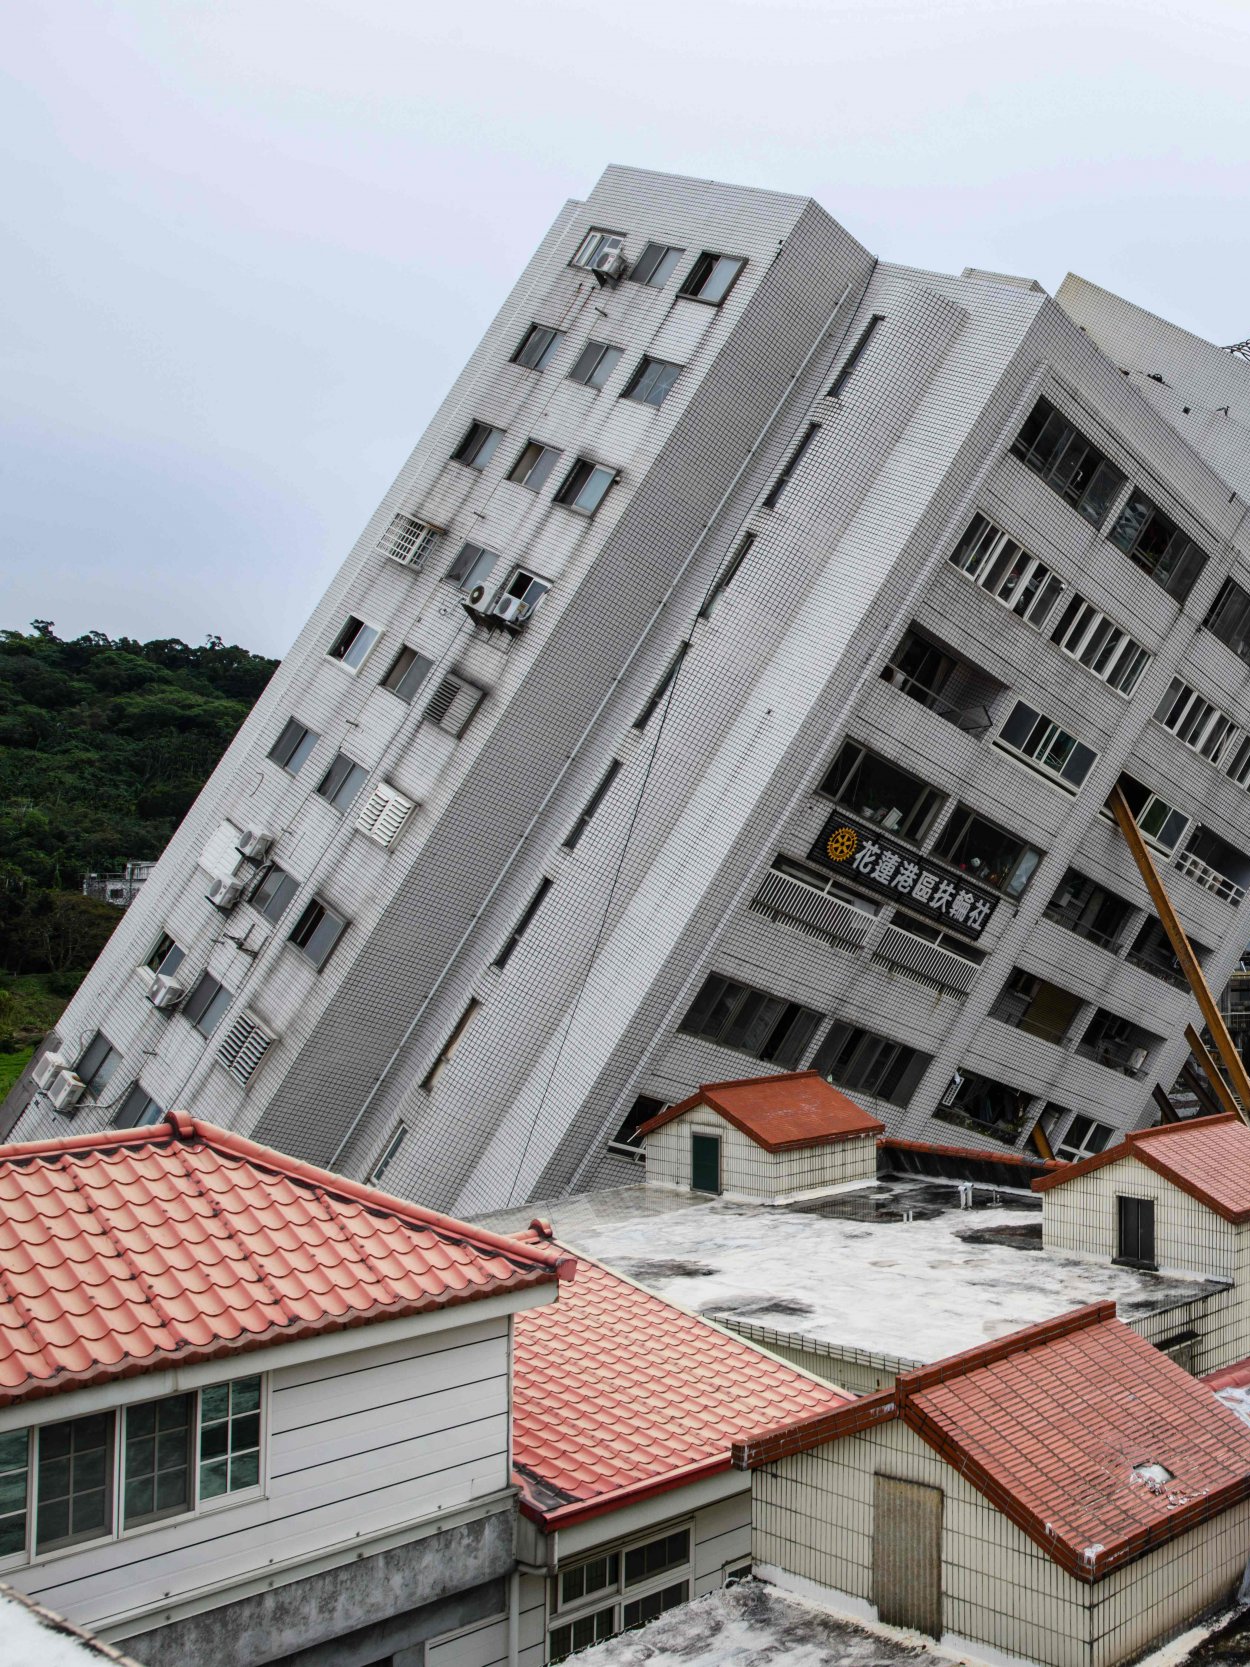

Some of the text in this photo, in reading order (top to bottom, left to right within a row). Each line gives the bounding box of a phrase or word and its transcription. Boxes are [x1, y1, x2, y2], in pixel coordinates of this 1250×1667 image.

[852, 840, 990, 931] 花蓮港區扶輪社
